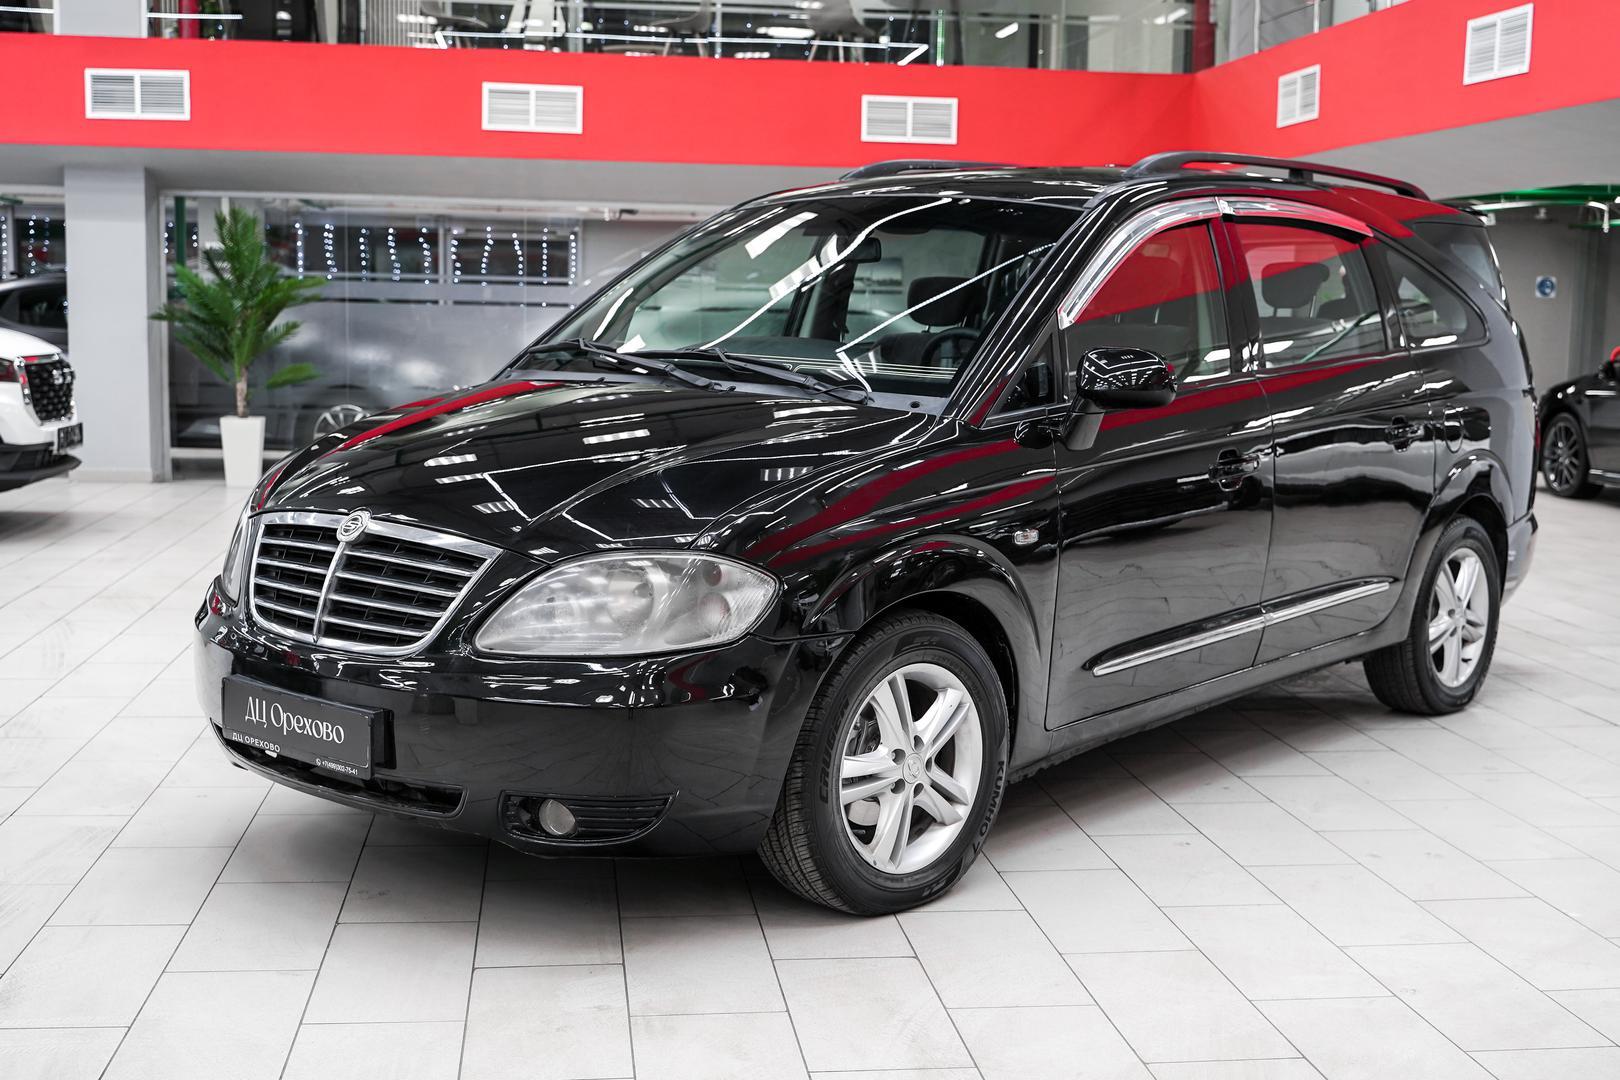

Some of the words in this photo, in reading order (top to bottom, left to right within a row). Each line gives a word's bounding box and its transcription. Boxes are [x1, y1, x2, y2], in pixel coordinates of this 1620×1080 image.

[232, 733, 243, 743] ДЦ
[244, 736, 280, 753] ОРЕХОВО
[245, 697, 267, 728] ДЦ
[271, 703, 344, 744] Орехово
[979, 761, 1004, 837] KUMHO
